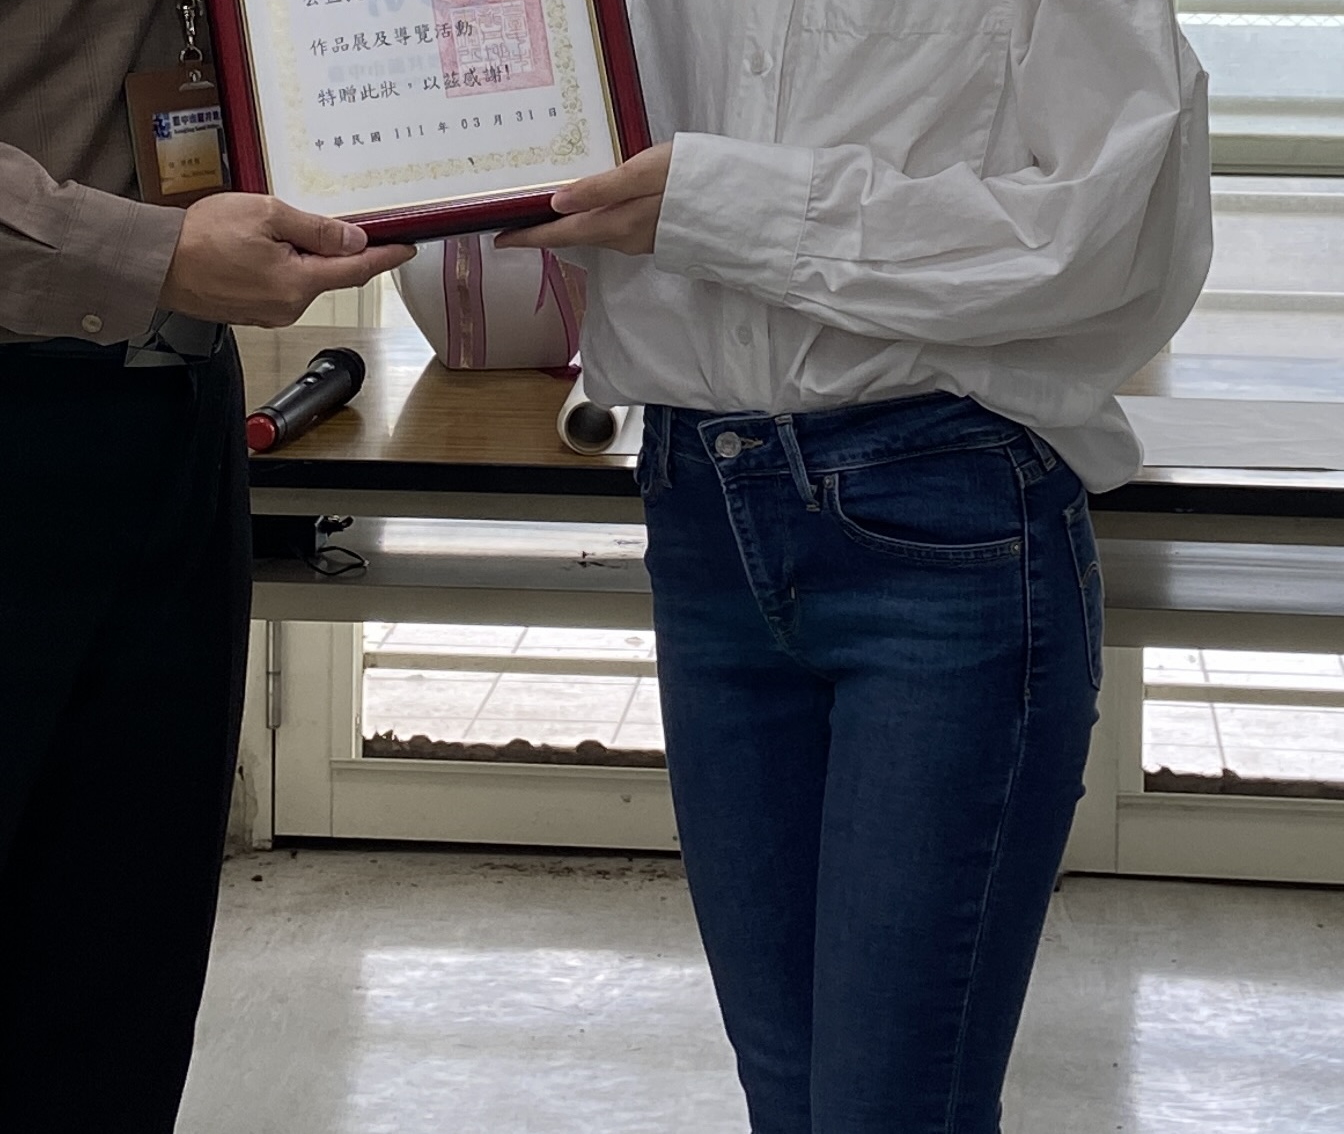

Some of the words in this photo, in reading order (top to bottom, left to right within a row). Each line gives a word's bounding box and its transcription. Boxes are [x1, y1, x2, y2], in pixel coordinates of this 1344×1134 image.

[310, 19, 473, 57] 作品展及導覽活動
